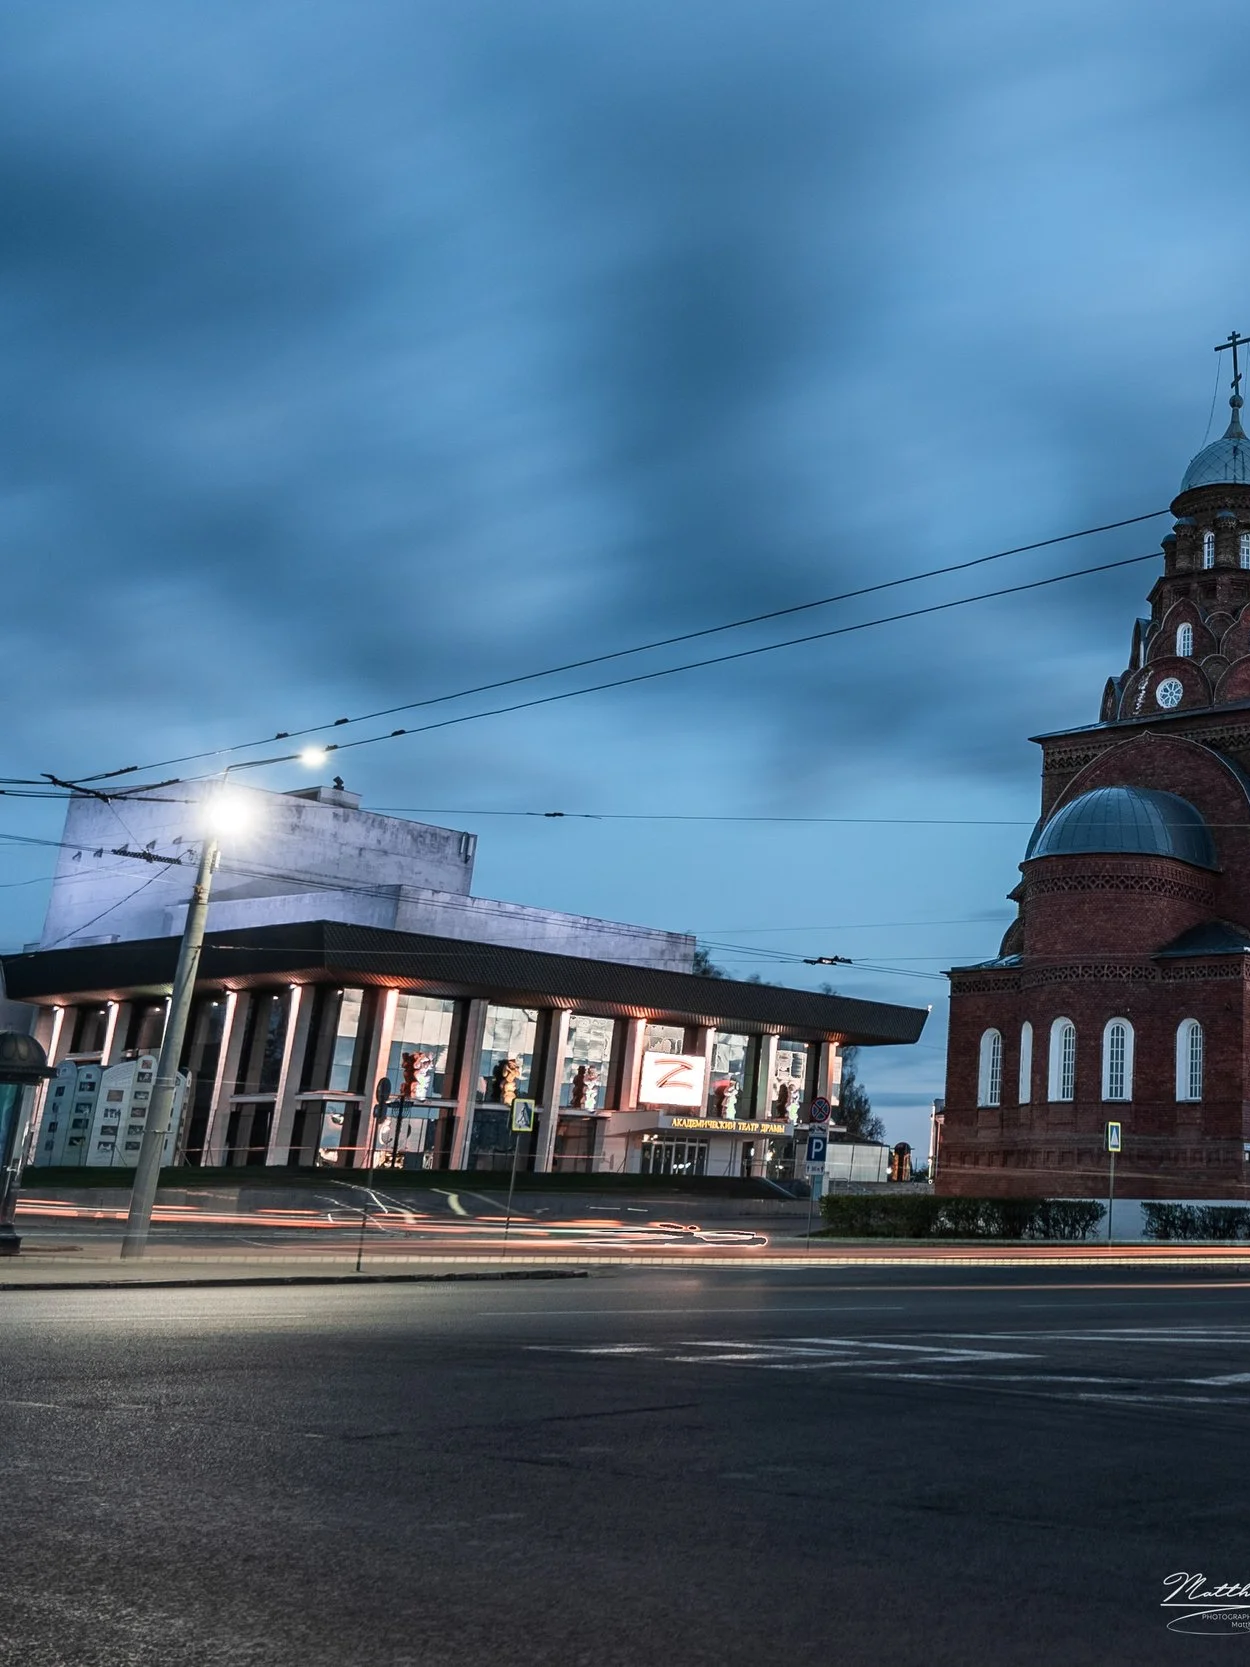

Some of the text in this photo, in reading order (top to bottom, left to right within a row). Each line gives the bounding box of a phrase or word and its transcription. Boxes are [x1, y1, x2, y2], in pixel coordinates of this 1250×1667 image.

[654, 1059, 693, 1090] Z
[738, 1122, 760, 1133] ТЕАТР
[760, 1124, 785, 1134] ДРАМЫ
[811, 1138, 824, 1160] P
